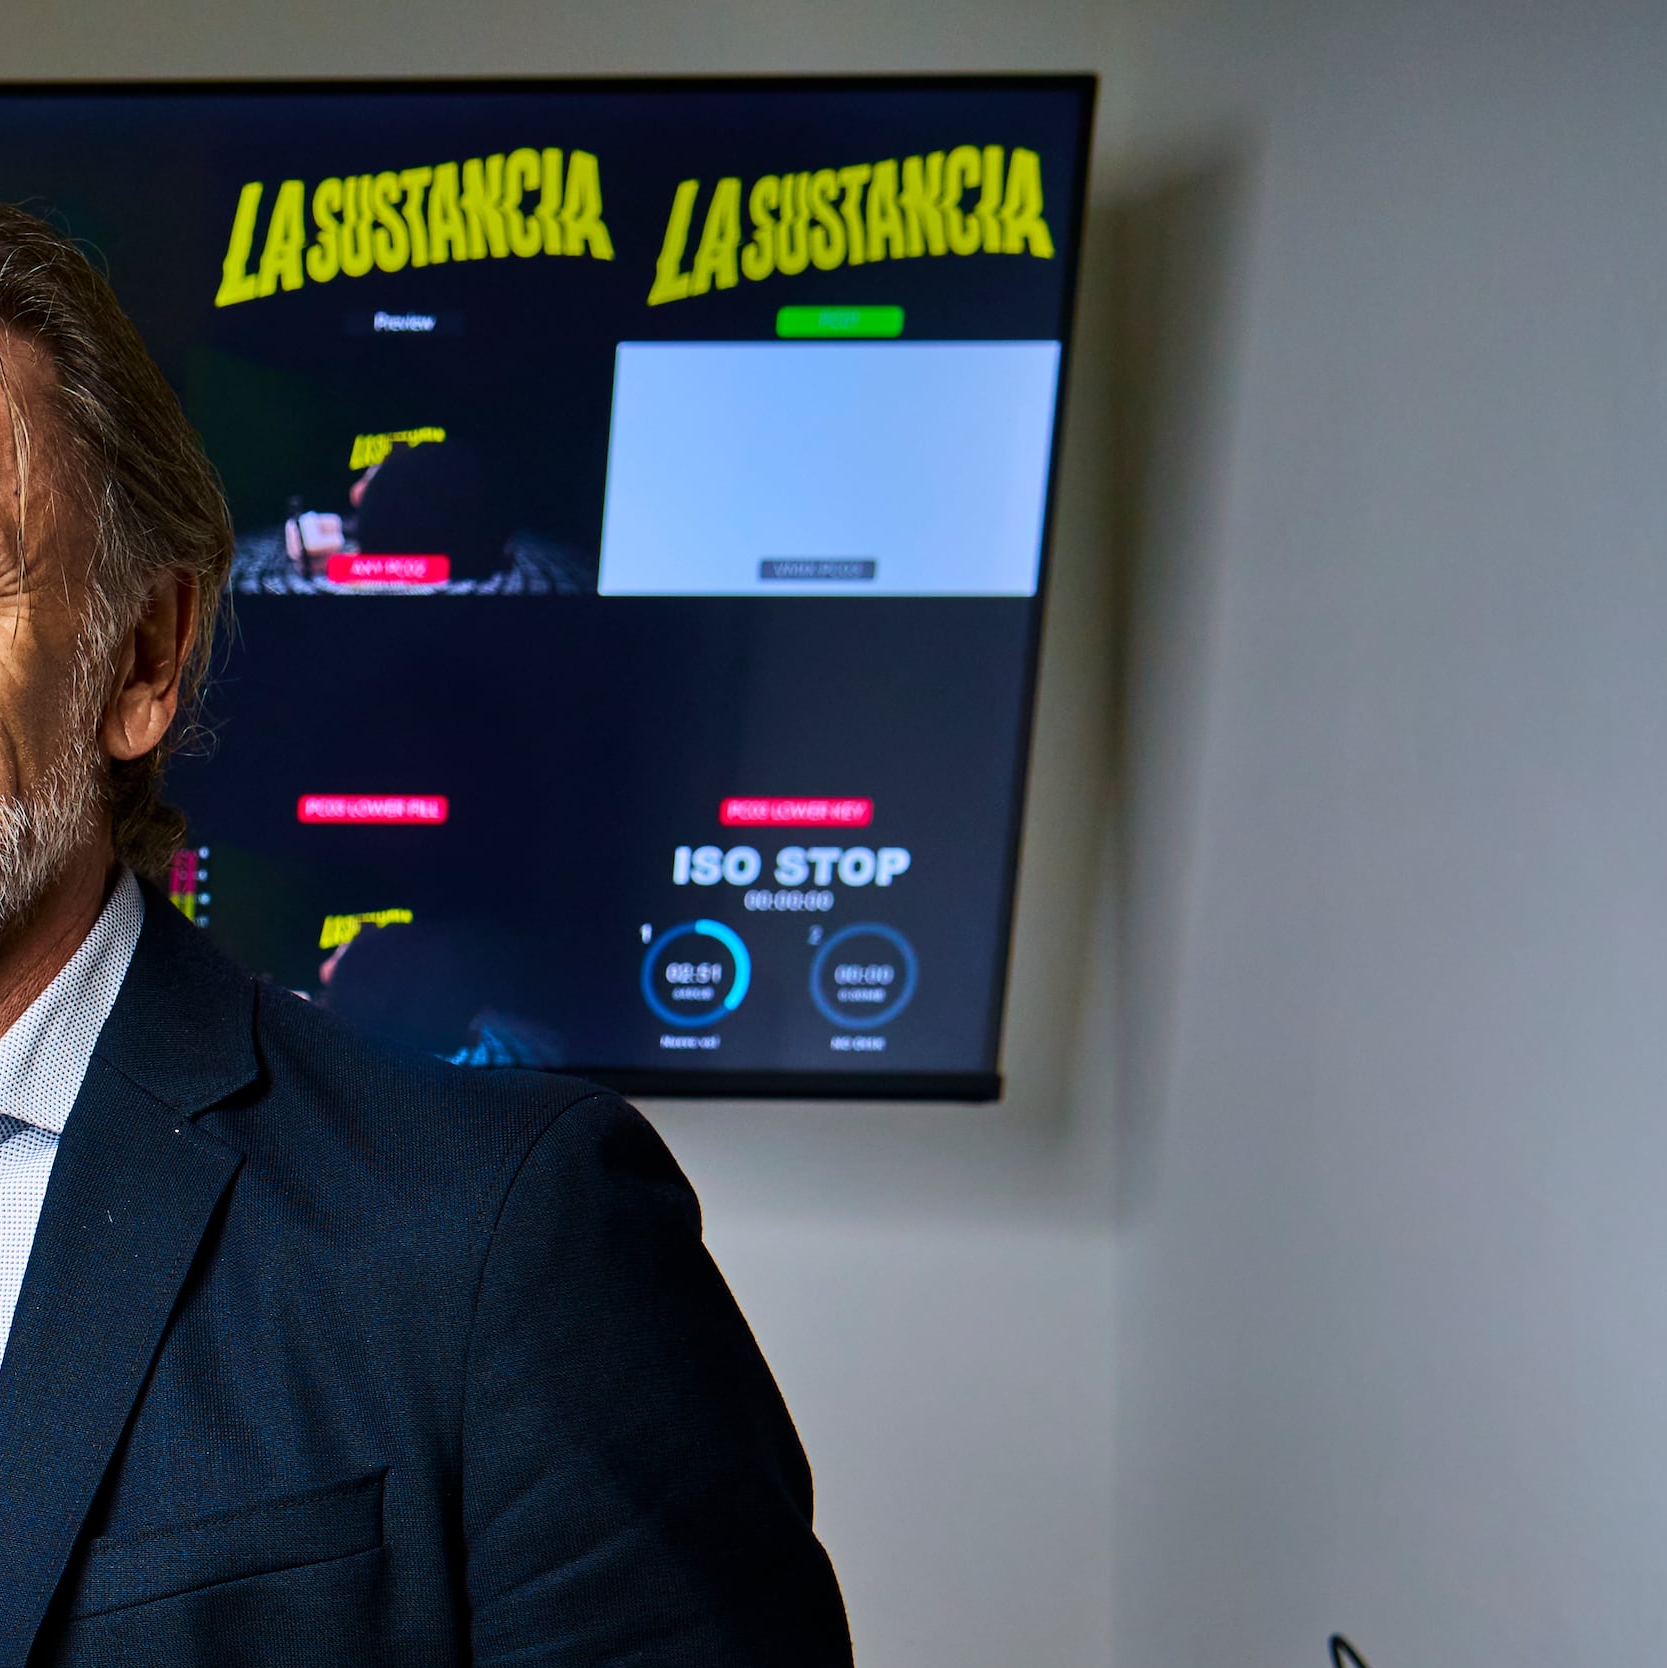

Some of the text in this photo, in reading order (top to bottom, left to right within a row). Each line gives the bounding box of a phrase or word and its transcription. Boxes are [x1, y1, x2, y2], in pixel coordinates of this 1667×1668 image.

[214, 147, 615, 308] LA SUSTANCIA
[647, 146, 1055, 306] LA SUSTANCIA
[373, 311, 436, 331] Preview
[673, 845, 912, 887] ISO STOP
